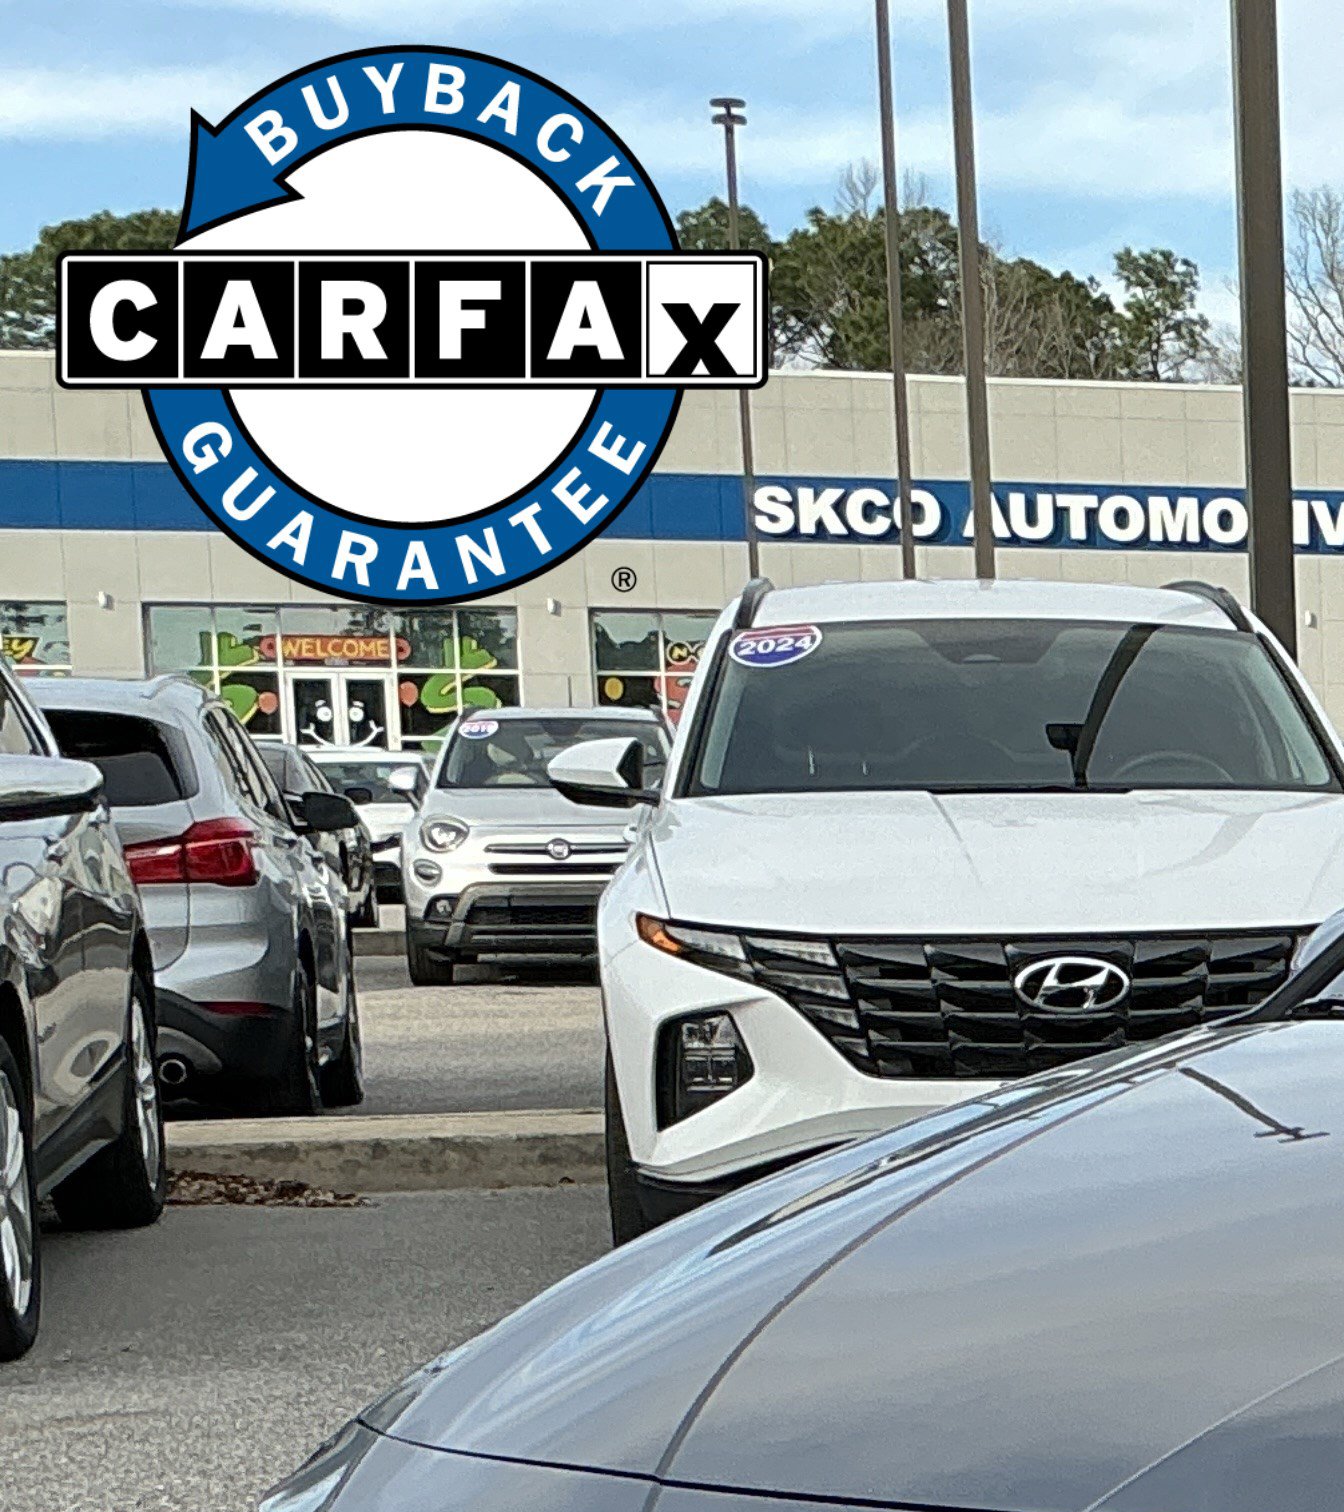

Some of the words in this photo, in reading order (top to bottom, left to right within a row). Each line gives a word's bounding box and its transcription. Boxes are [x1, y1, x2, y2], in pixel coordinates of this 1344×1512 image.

[753, 485, 942, 537] SKCO
[282, 637, 391, 658] WELCOME
[737, 635, 813, 656] 2024
